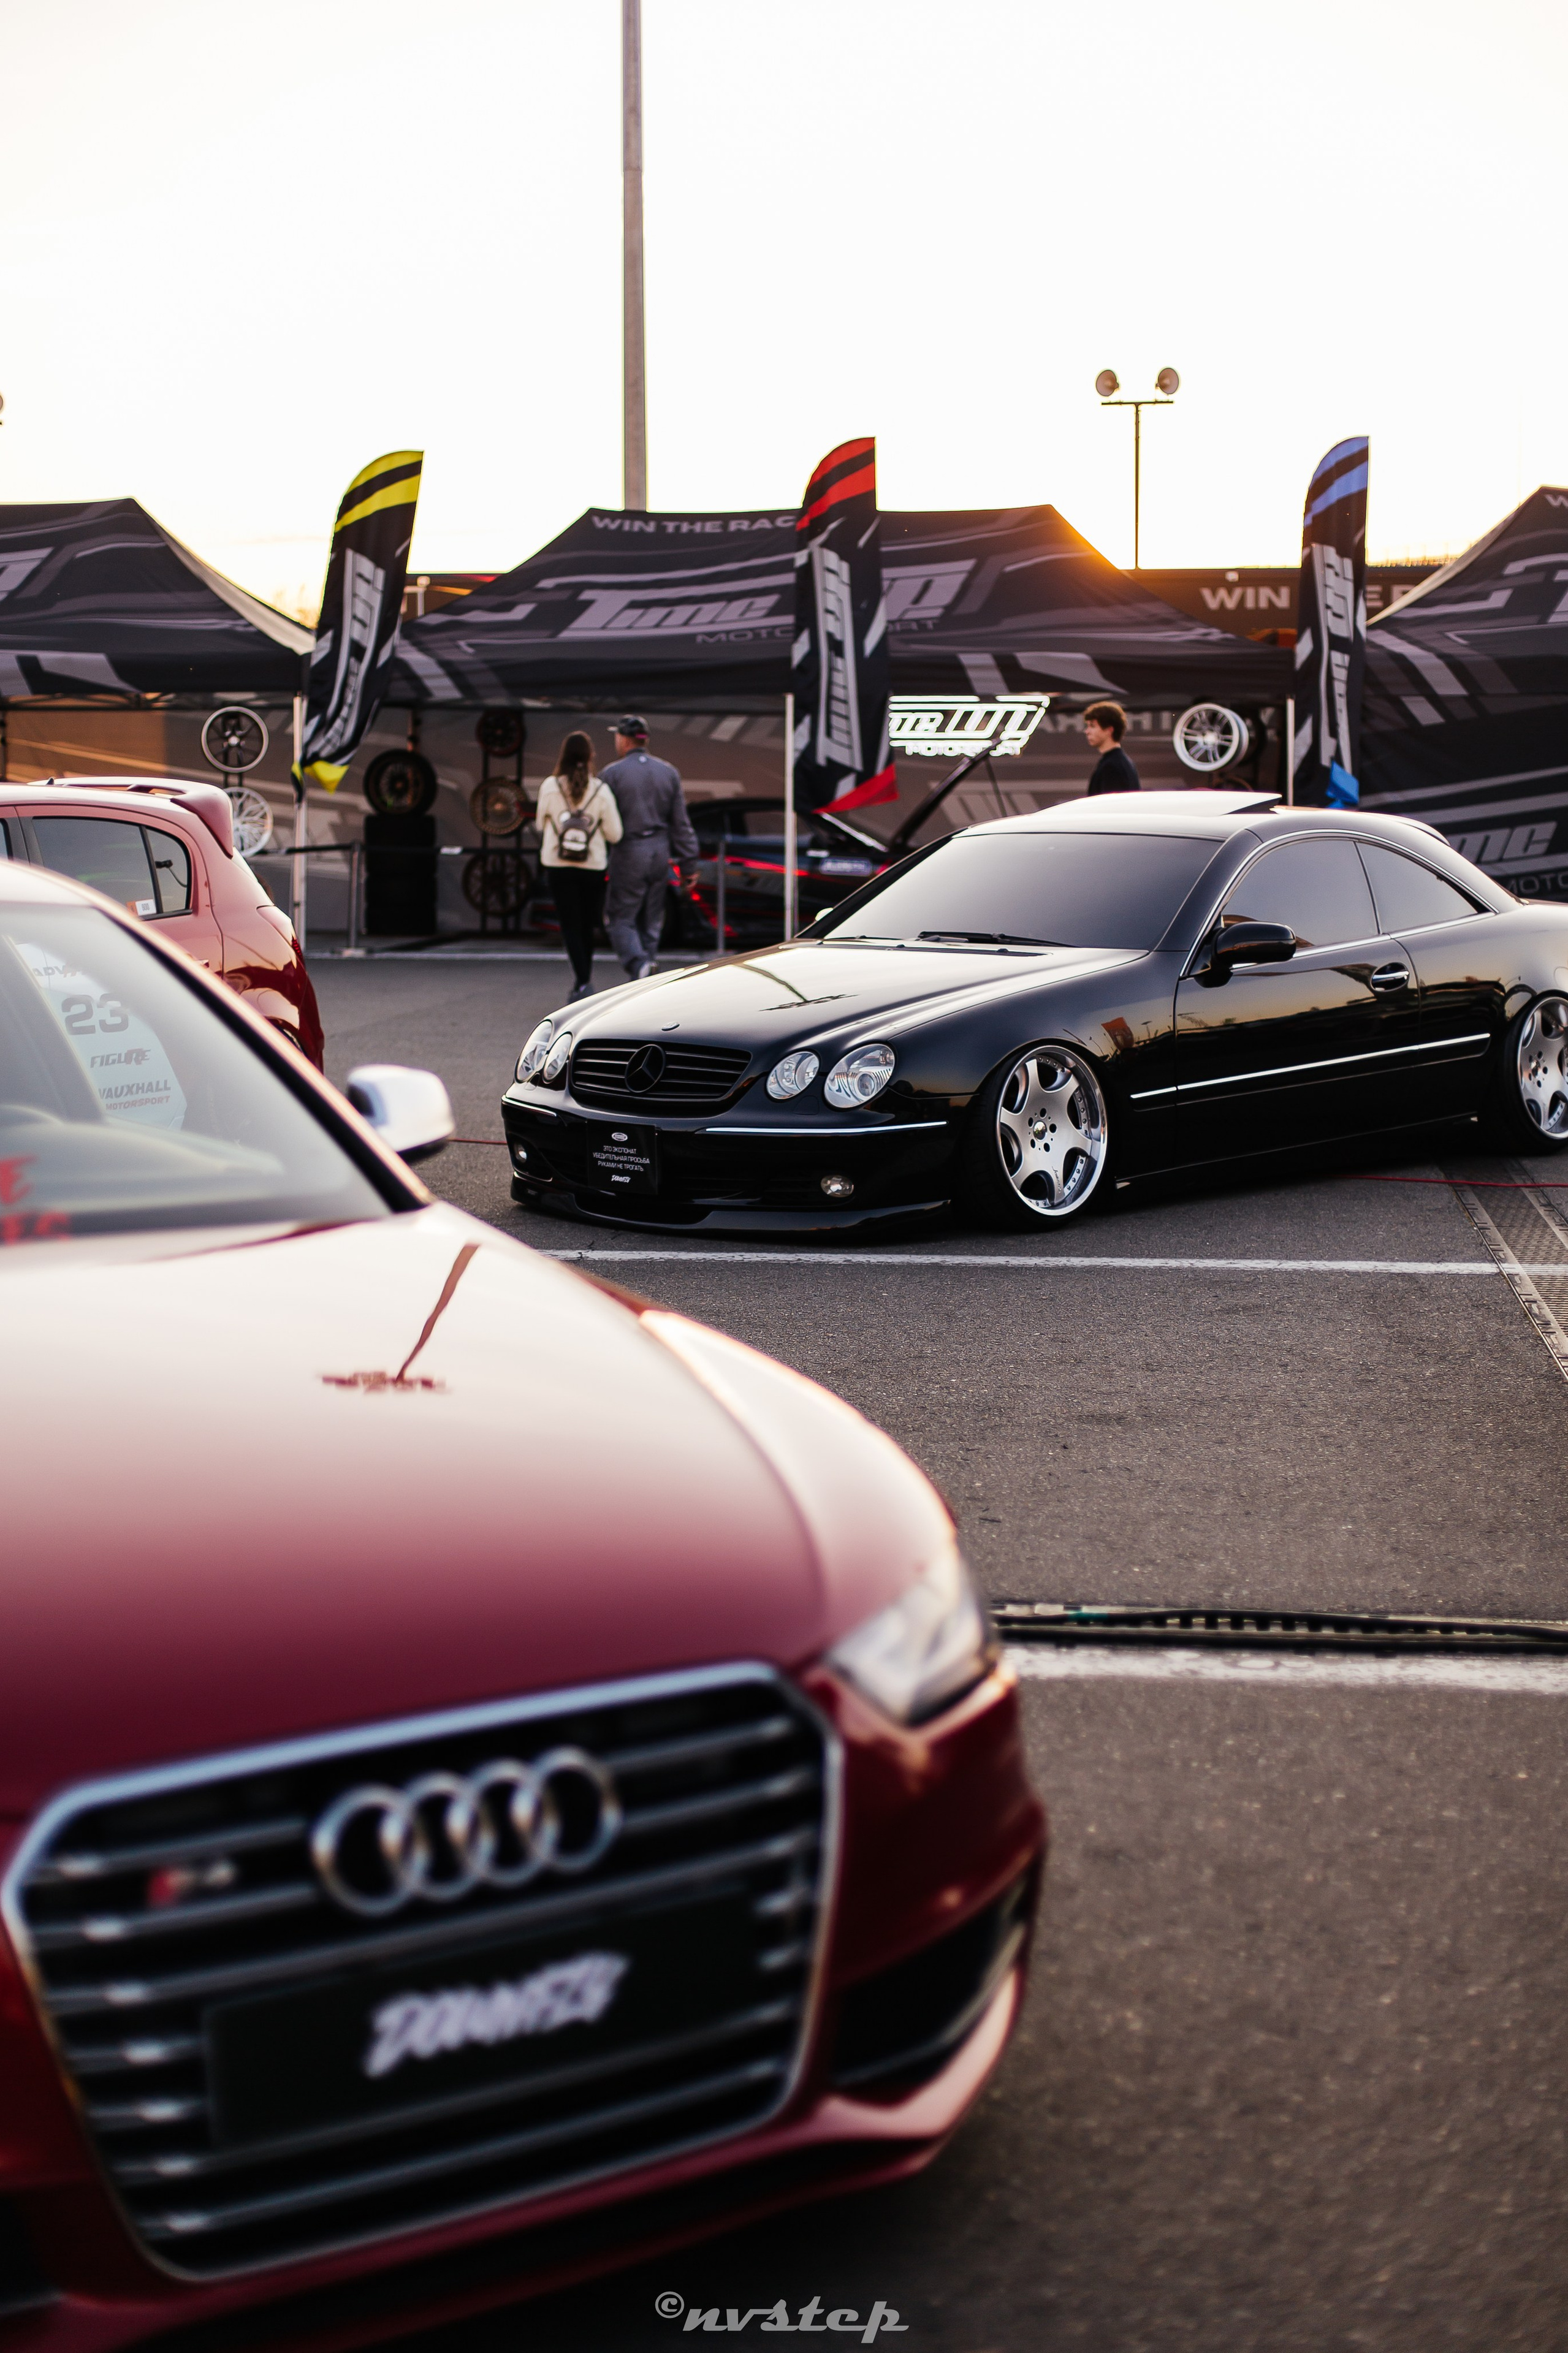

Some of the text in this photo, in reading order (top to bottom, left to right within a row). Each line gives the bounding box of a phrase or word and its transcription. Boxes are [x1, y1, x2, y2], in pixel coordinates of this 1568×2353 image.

[592, 515, 796, 533] WIN THE RAC
[1199, 585, 1290, 610] WIN
[61, 992, 129, 1036] 23
[90, 1047, 151, 1068] FIGURE
[98, 1079, 172, 1100] VAUXHALL
[105, 1095, 170, 1111] MOTORSPORT
[593, 1152, 626, 1161] УБЕДИТЕЛЬНАЯ
